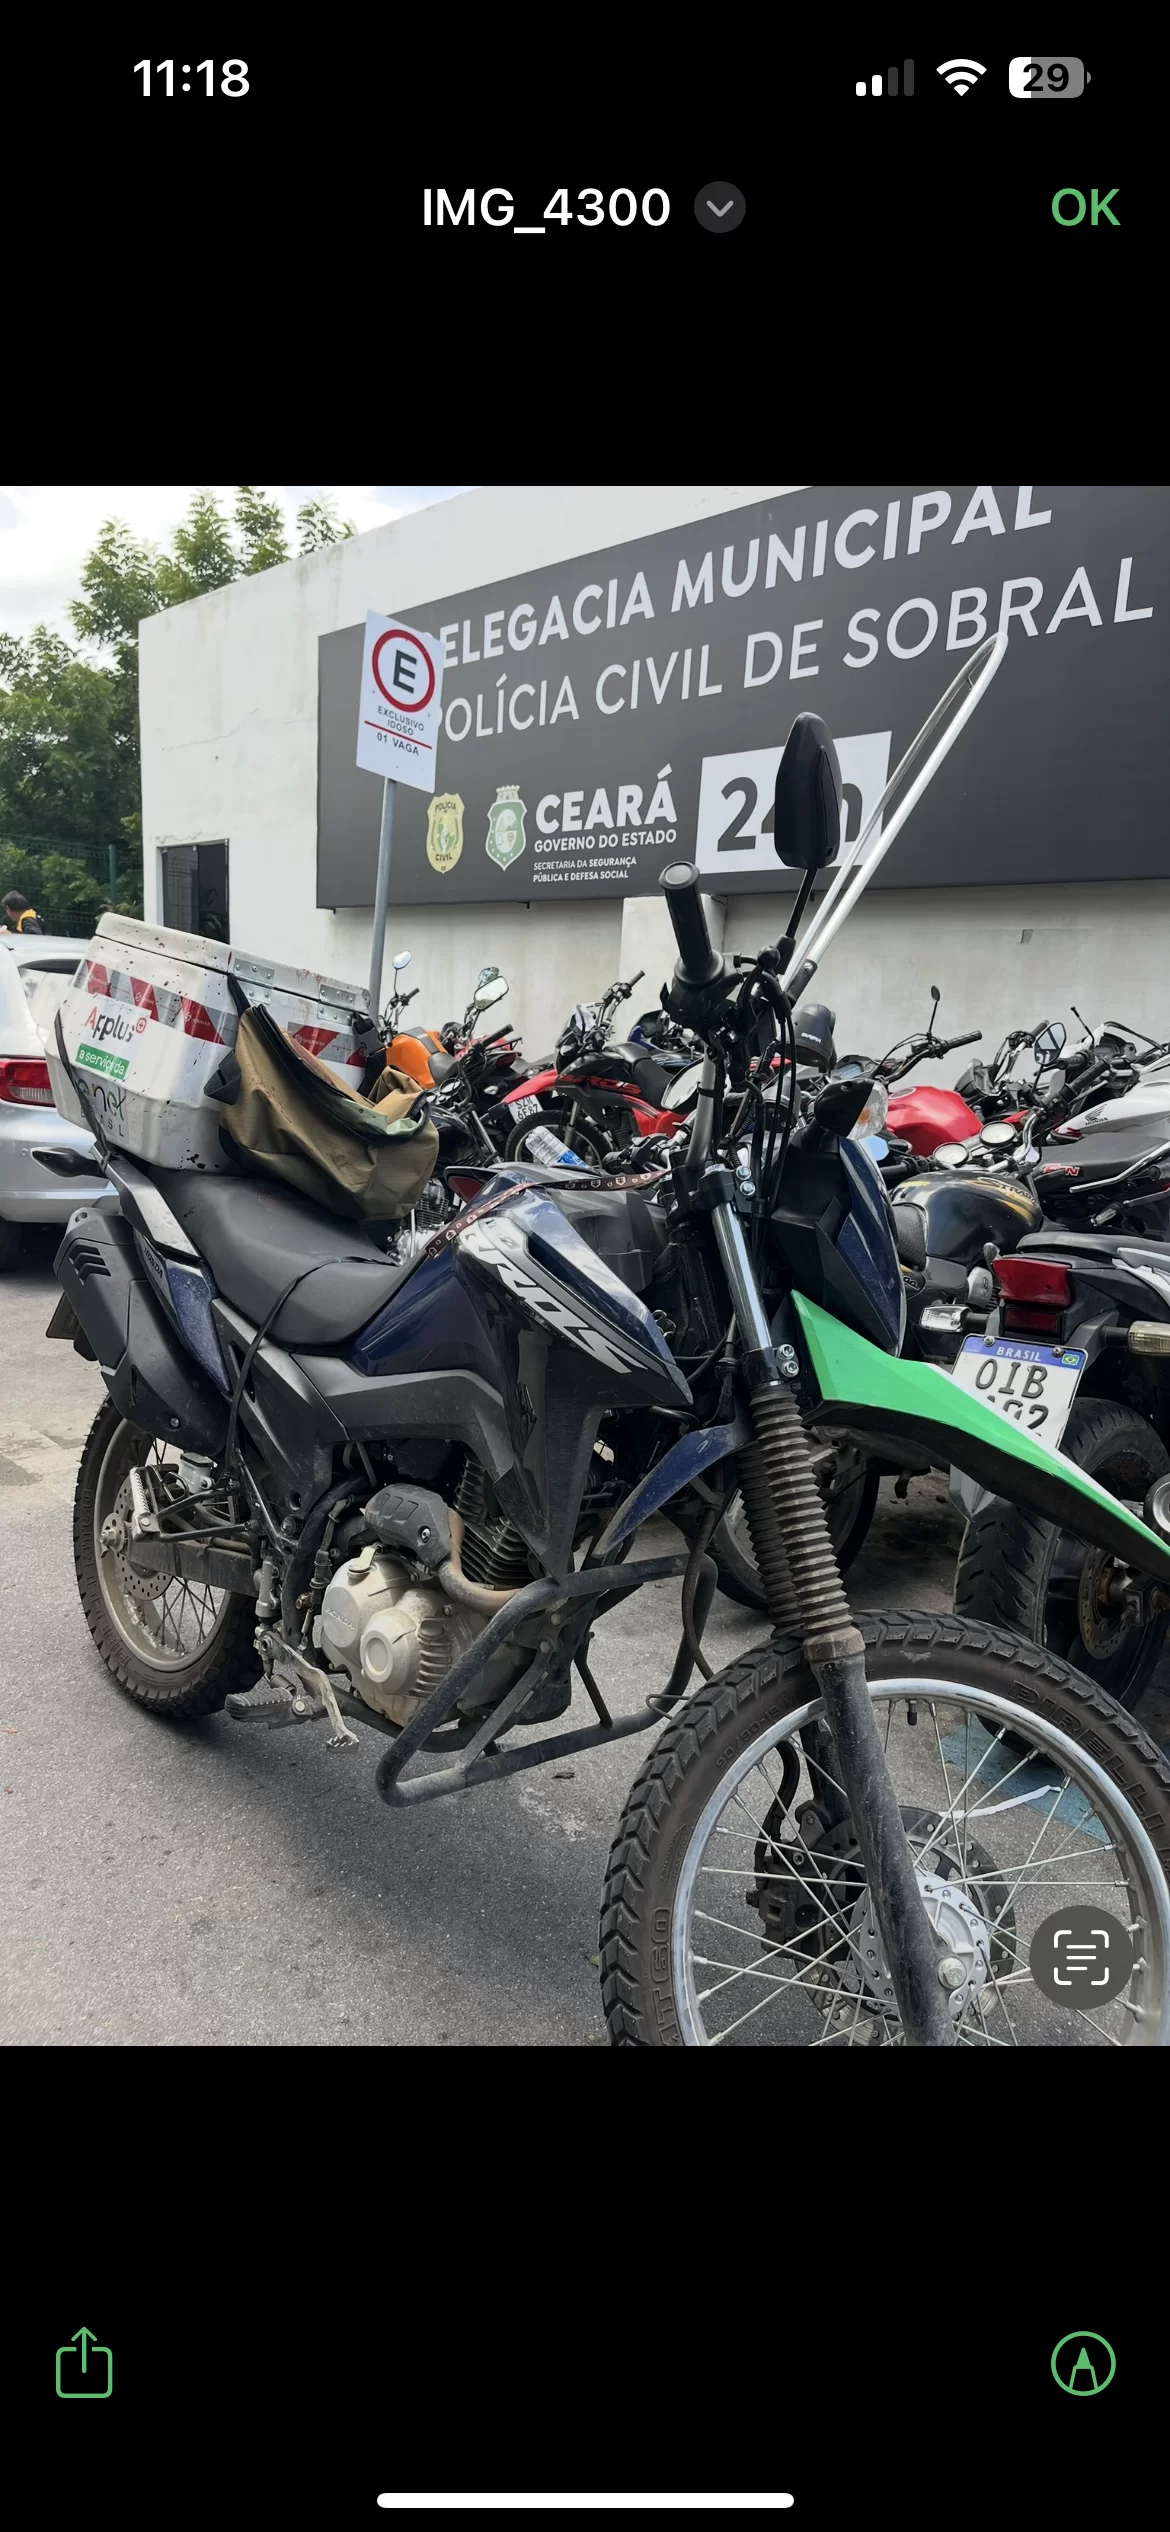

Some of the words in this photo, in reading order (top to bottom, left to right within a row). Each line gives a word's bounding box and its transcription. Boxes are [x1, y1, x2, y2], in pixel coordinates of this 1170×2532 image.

[424, 571, 655, 668] ELEGACIA
[671, 486, 1052, 612] MUNICIPAL
[438, 673, 579, 742] OLÍCIA
[596, 644, 722, 714] CIVIL
[744, 619, 823, 688] DE
[843, 557, 1153, 668] SOBRAL
[393, 649, 417, 694] E
[377, 705, 424, 731] EXCLUSIVO
[387, 719, 414, 736] IDOSO
[377, 732, 388, 743] 01
[392, 737, 419, 755] VAGA
[535, 763, 677, 834] CEARÁ
[534, 836, 595, 852] GOVERNO
[598, 834, 618, 848] DO
[621, 829, 677, 846] ESTADO
[435, 853, 453, 862] CIVIL
[533, 861, 575, 870] SECRETARIA
[577, 860, 587, 868] DA
[589, 856, 637, 868] SEGURANÇA
[533, 872, 563, 882] PÚBLICA
[570, 872, 599, 880] DEFESA
[600, 870, 628, 879] SOCIAL
[79, 1050, 84, 1059] a
[113, 1059, 125, 1074] da
[143, 1247, 164, 1280] HONDA
[996, 1346, 1042, 1362] BRASIL
[1007, 1680, 1166, 1830] PIRELLI
